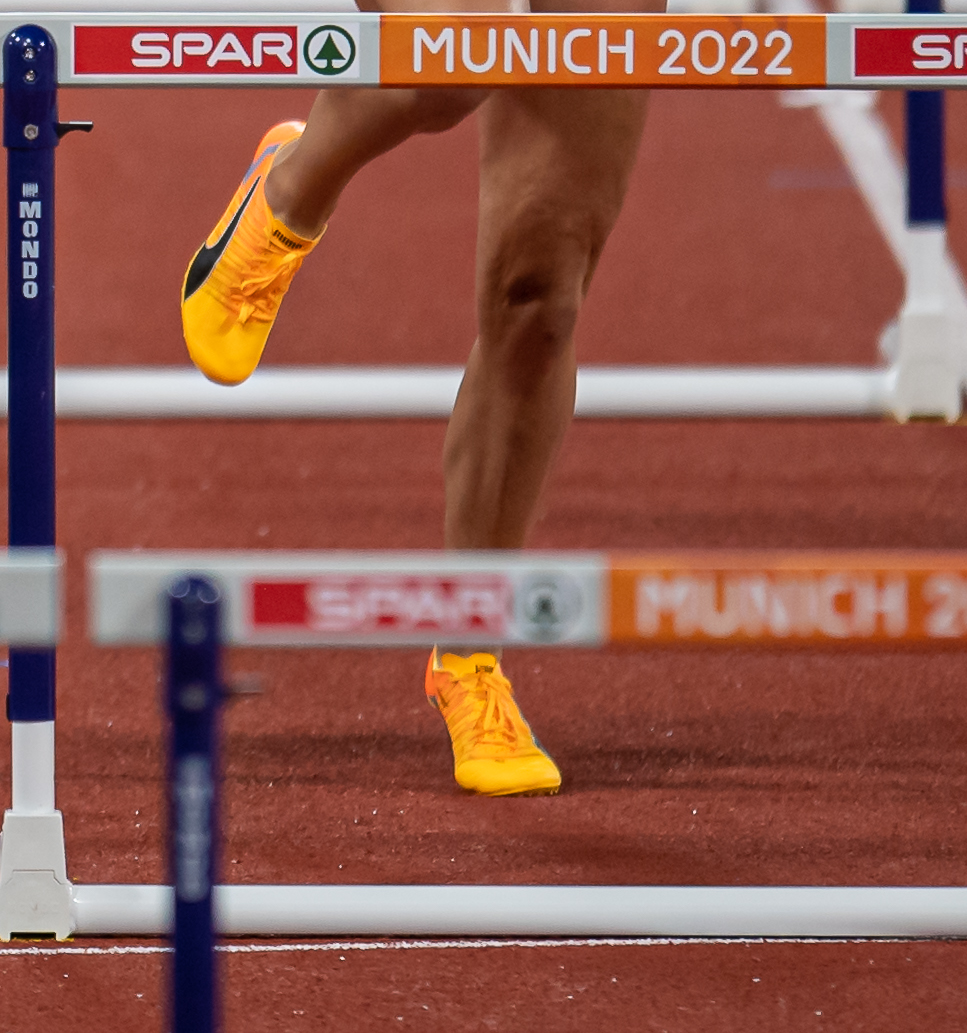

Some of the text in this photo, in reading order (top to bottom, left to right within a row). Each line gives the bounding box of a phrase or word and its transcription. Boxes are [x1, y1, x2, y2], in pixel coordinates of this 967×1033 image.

[130, 32, 293, 69] SPAR
[413, 27, 793, 75] MUNICH 2022
[19, 200, 42, 299] MONDO
[309, 583, 508, 635] SPAR
[636, 573, 908, 637] MUNICH
